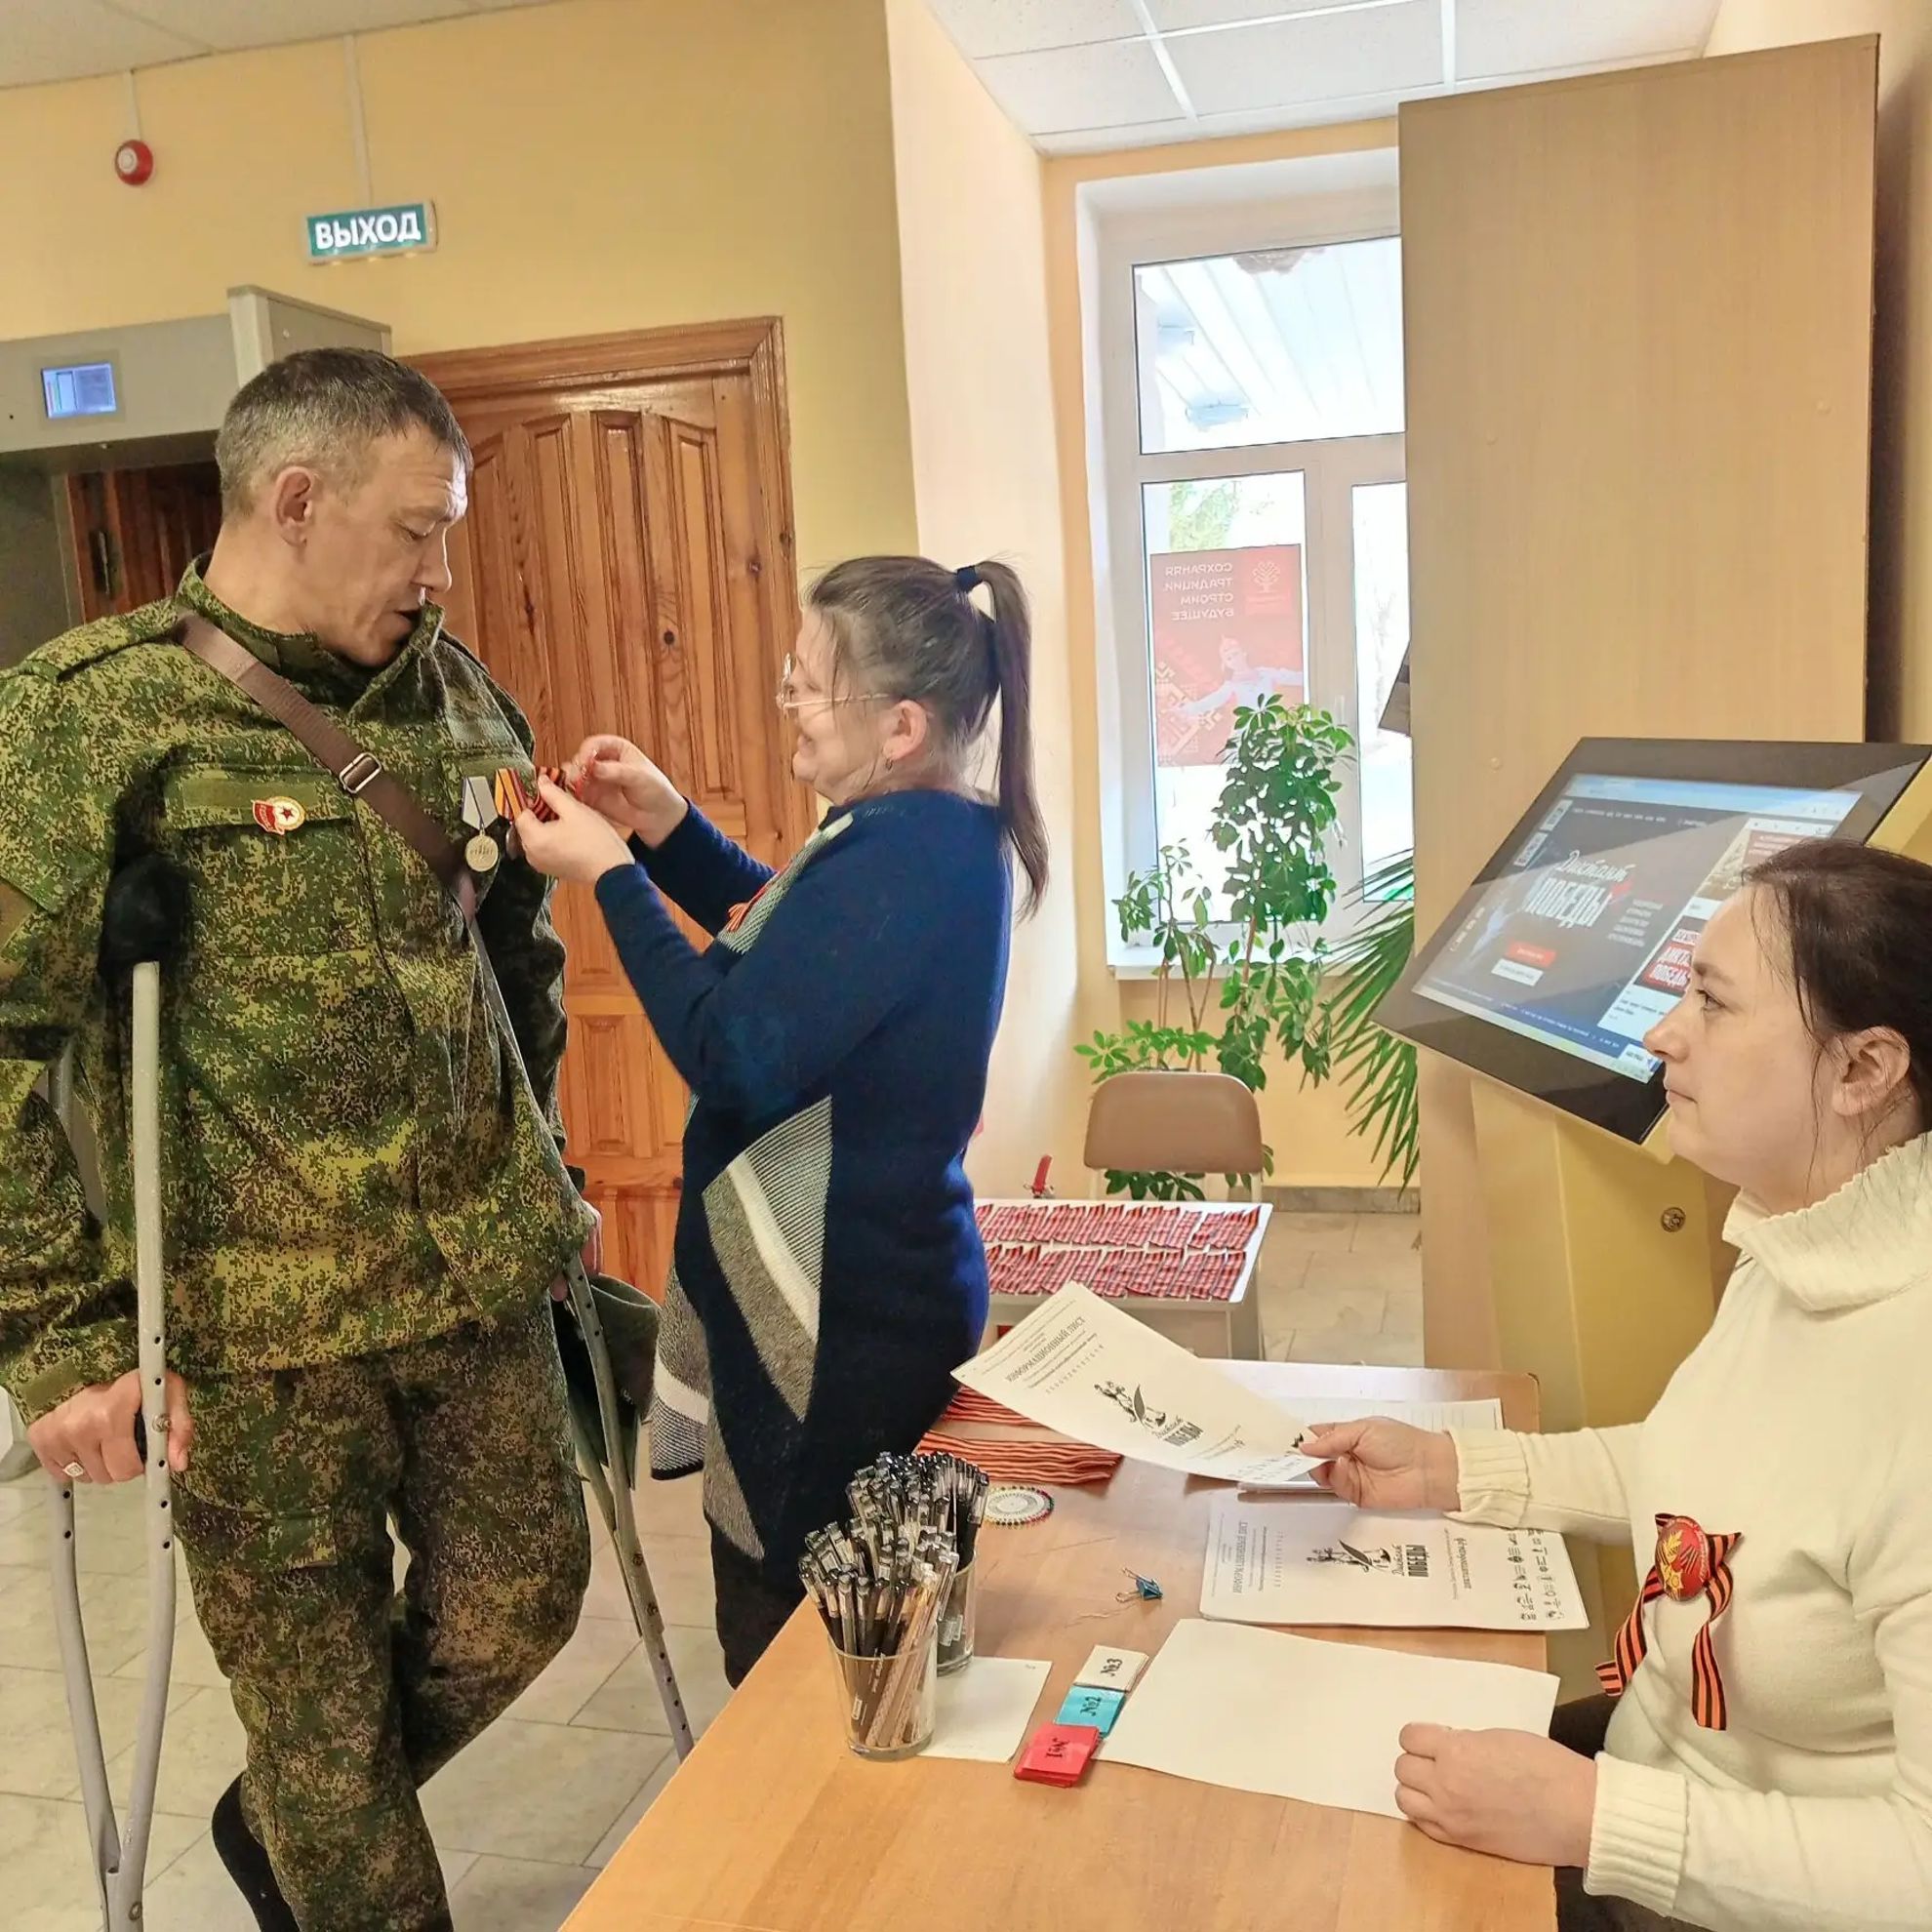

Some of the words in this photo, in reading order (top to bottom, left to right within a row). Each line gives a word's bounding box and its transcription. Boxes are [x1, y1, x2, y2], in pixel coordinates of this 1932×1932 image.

[314, 211, 422, 250] ВЫХОД
[1524, 877, 1613, 928] ПОБЕДЫ
[1406, 1545, 1429, 1578] ПОБЕДЫ
[1100, 1658, 1123, 1677] №3
[1080, 1696, 1102, 1717] №2
